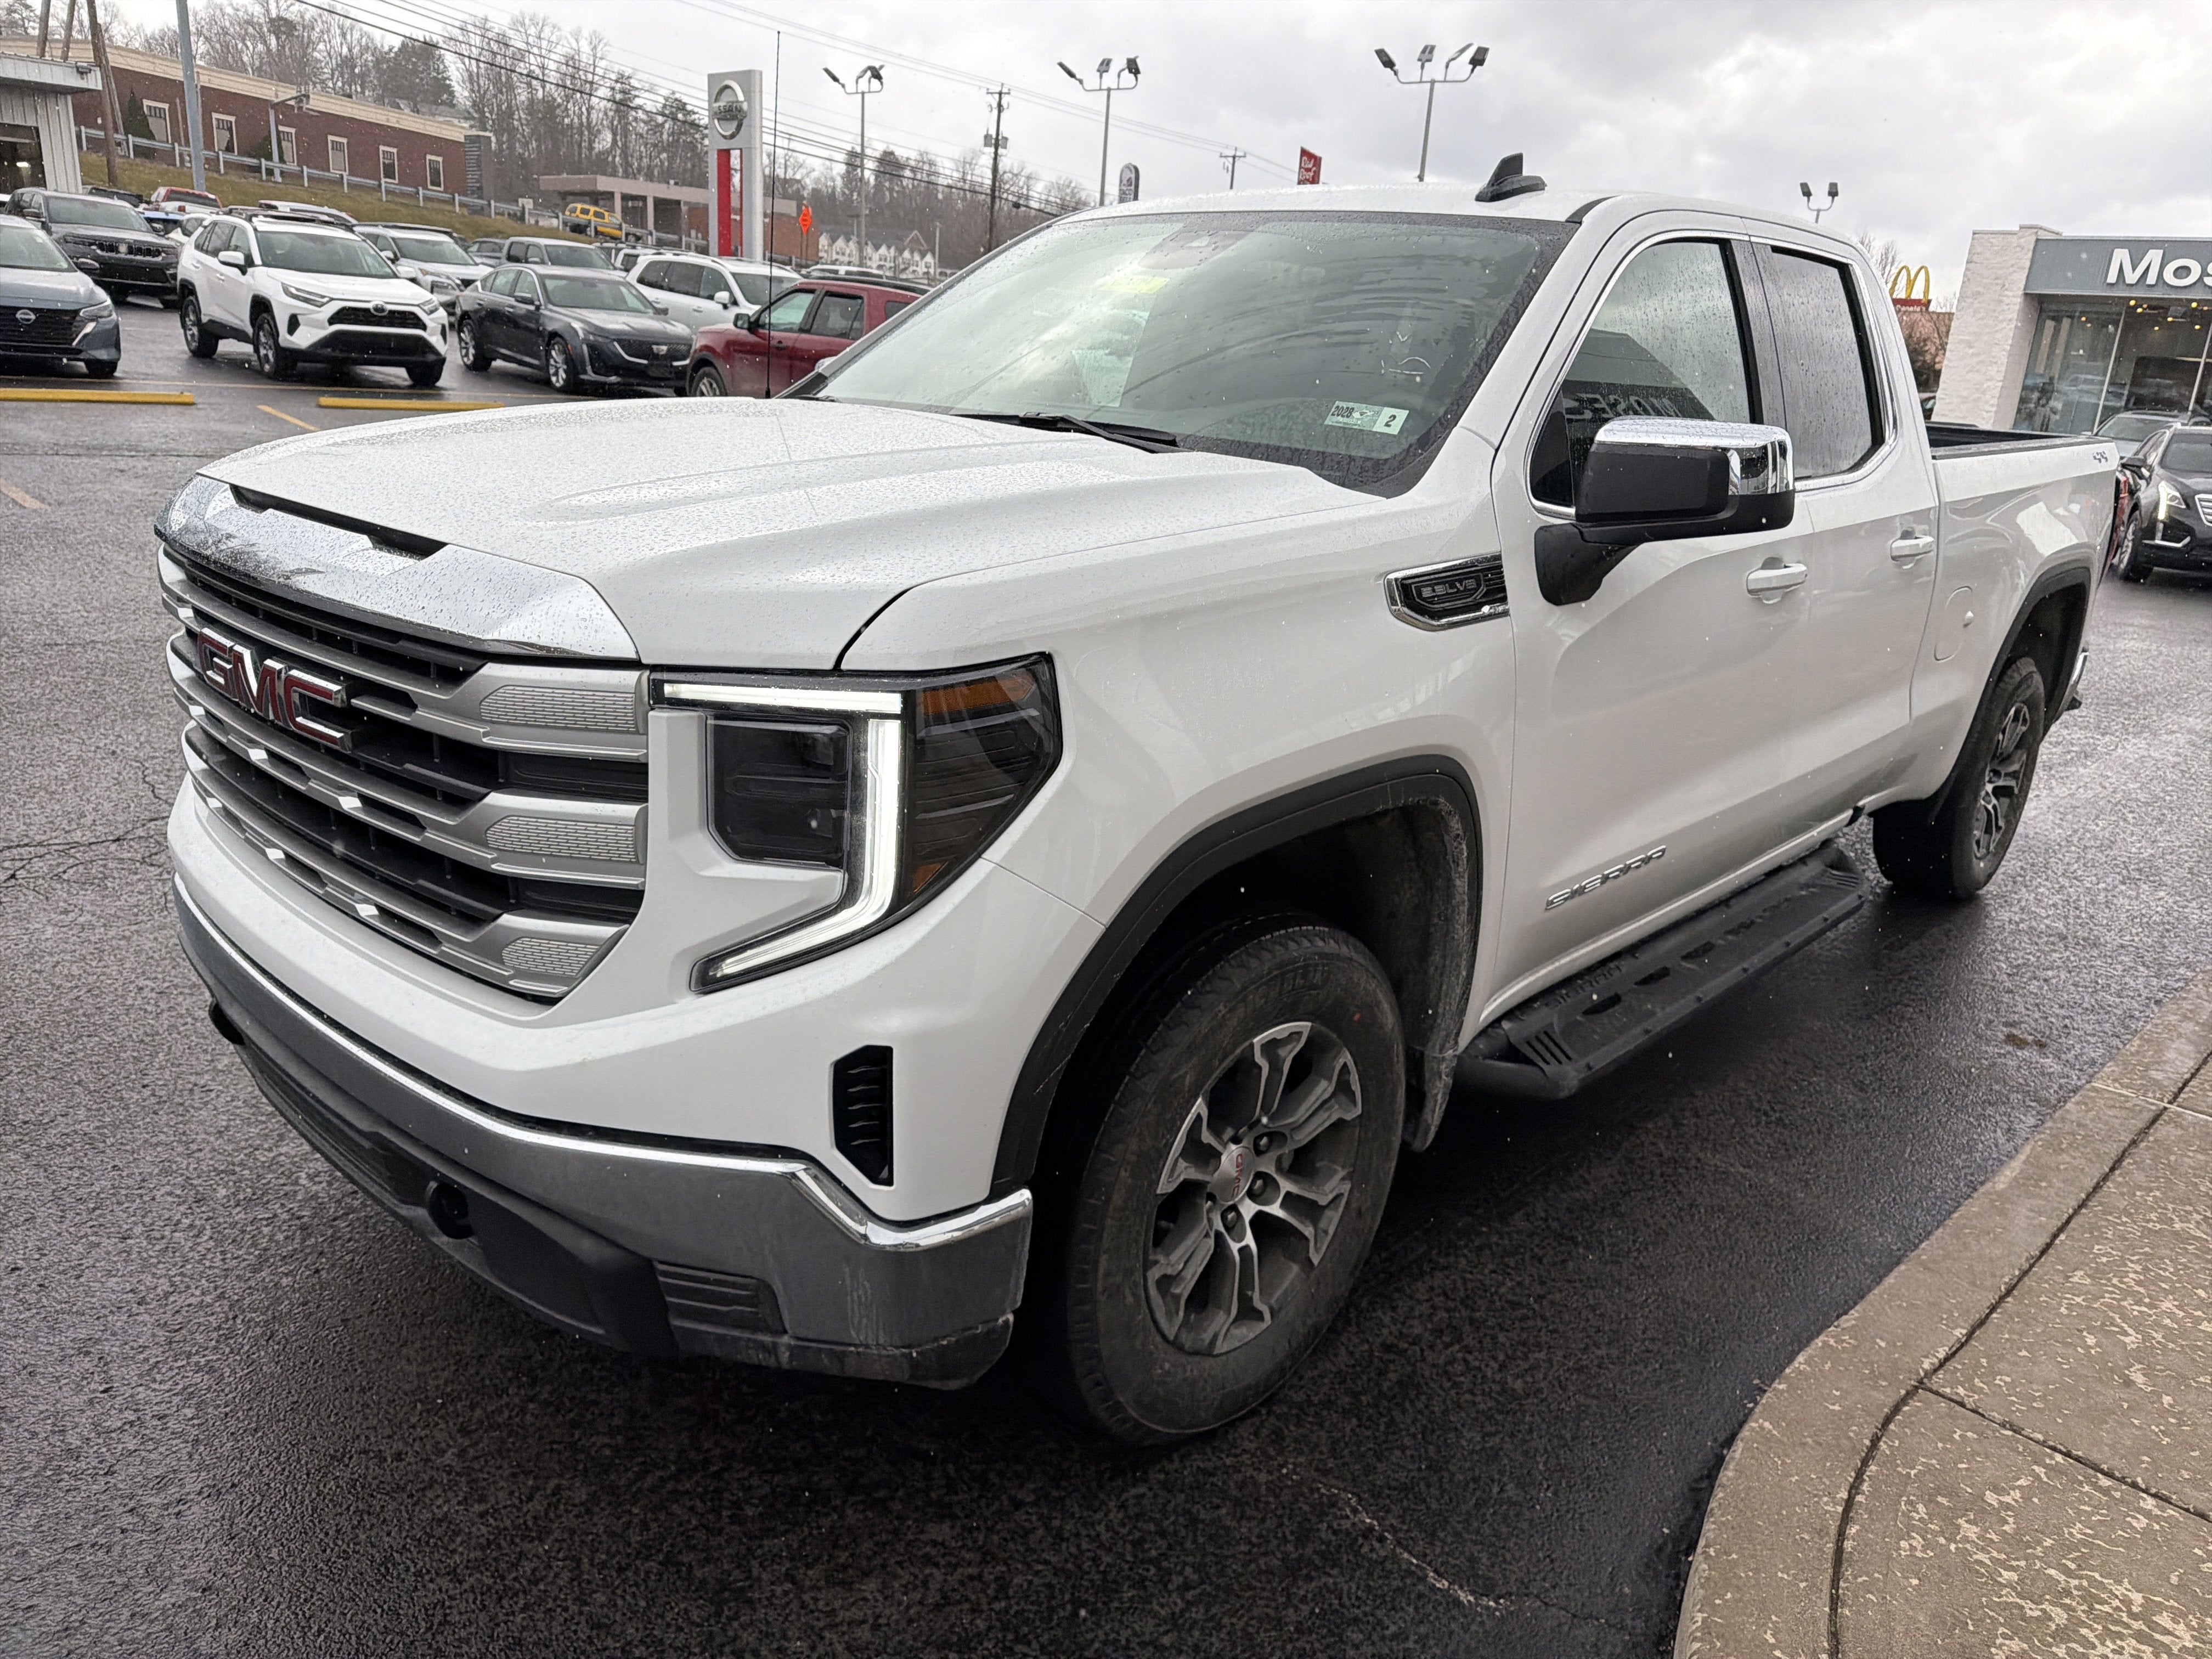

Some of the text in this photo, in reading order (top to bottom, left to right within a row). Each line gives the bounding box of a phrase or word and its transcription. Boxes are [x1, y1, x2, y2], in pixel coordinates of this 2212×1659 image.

[2106, 248, 2212, 287] Mo
[1330, 405, 1397, 427] 2028 2
[198, 628, 352, 753] GMC
[1544, 845, 1667, 911] SIERRA
